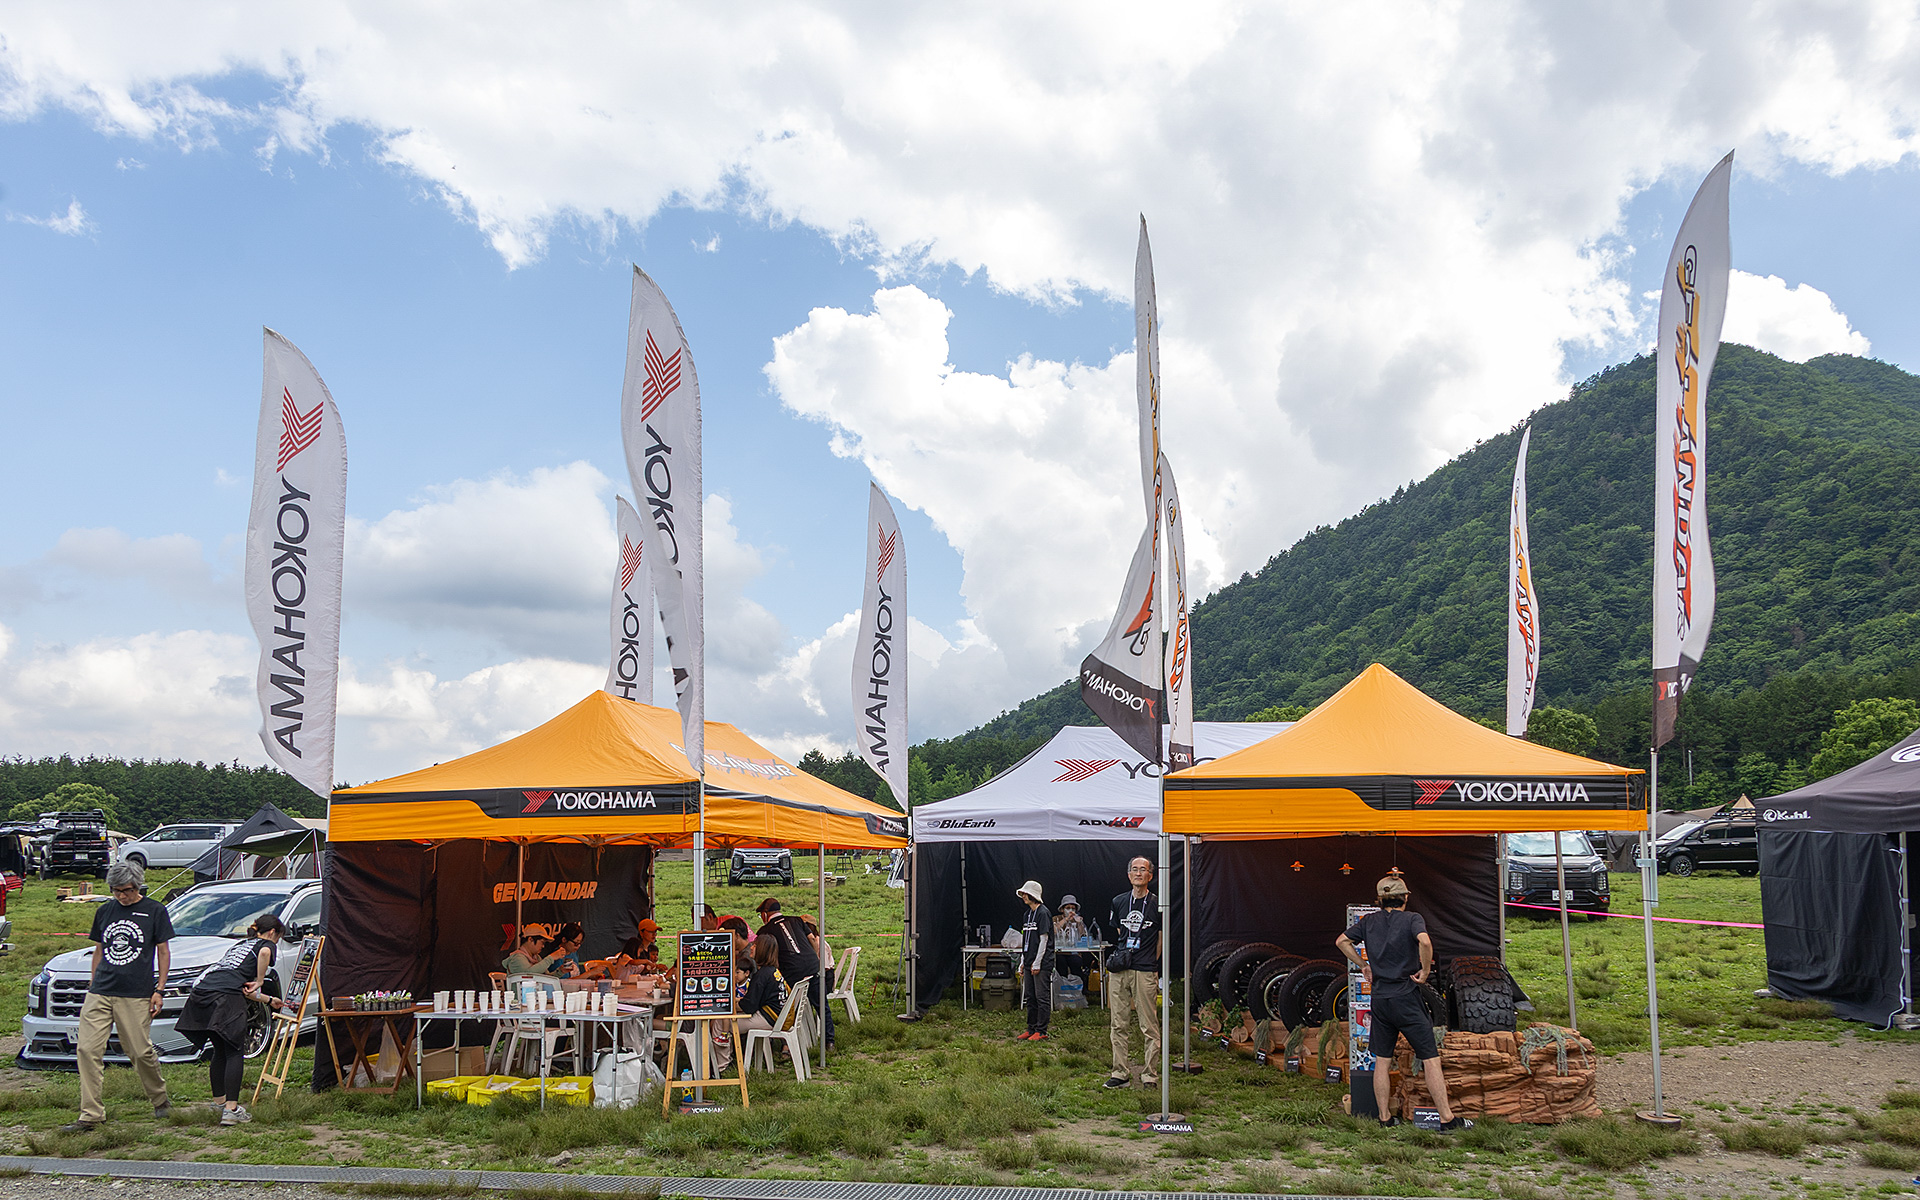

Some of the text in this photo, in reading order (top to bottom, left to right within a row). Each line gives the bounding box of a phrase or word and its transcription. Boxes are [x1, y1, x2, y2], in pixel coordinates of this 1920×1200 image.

[1454, 782, 1590, 802] YOKOHAMA
[553, 791, 657, 810] YOKOHAMA
[939, 818, 996, 829] BluEarth
[1078, 818, 1140, 829] ADVAN
[493, 881, 598, 904] GEOLANDAR
[1151, 1123, 1193, 1132] YOKOHAMA
